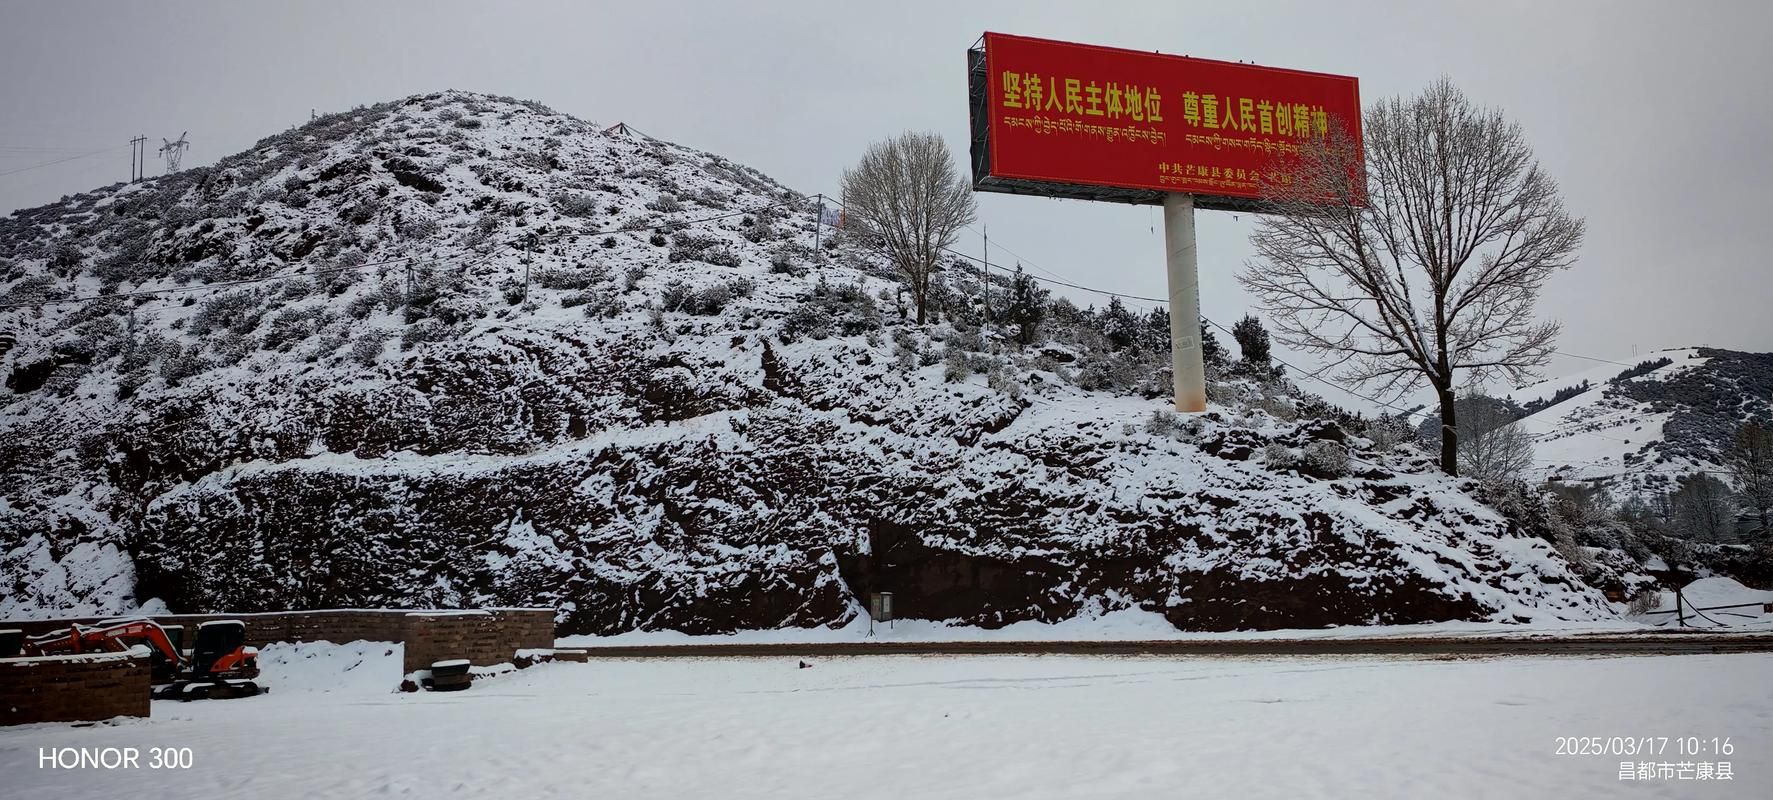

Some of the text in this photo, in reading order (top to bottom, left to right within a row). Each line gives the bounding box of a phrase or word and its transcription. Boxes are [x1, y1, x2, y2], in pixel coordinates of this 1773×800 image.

[1003, 70, 1328, 138] 坚持人民主体地位 尊重人民首创精神
[1159, 162, 1261, 182] 中共芒康县委员会
